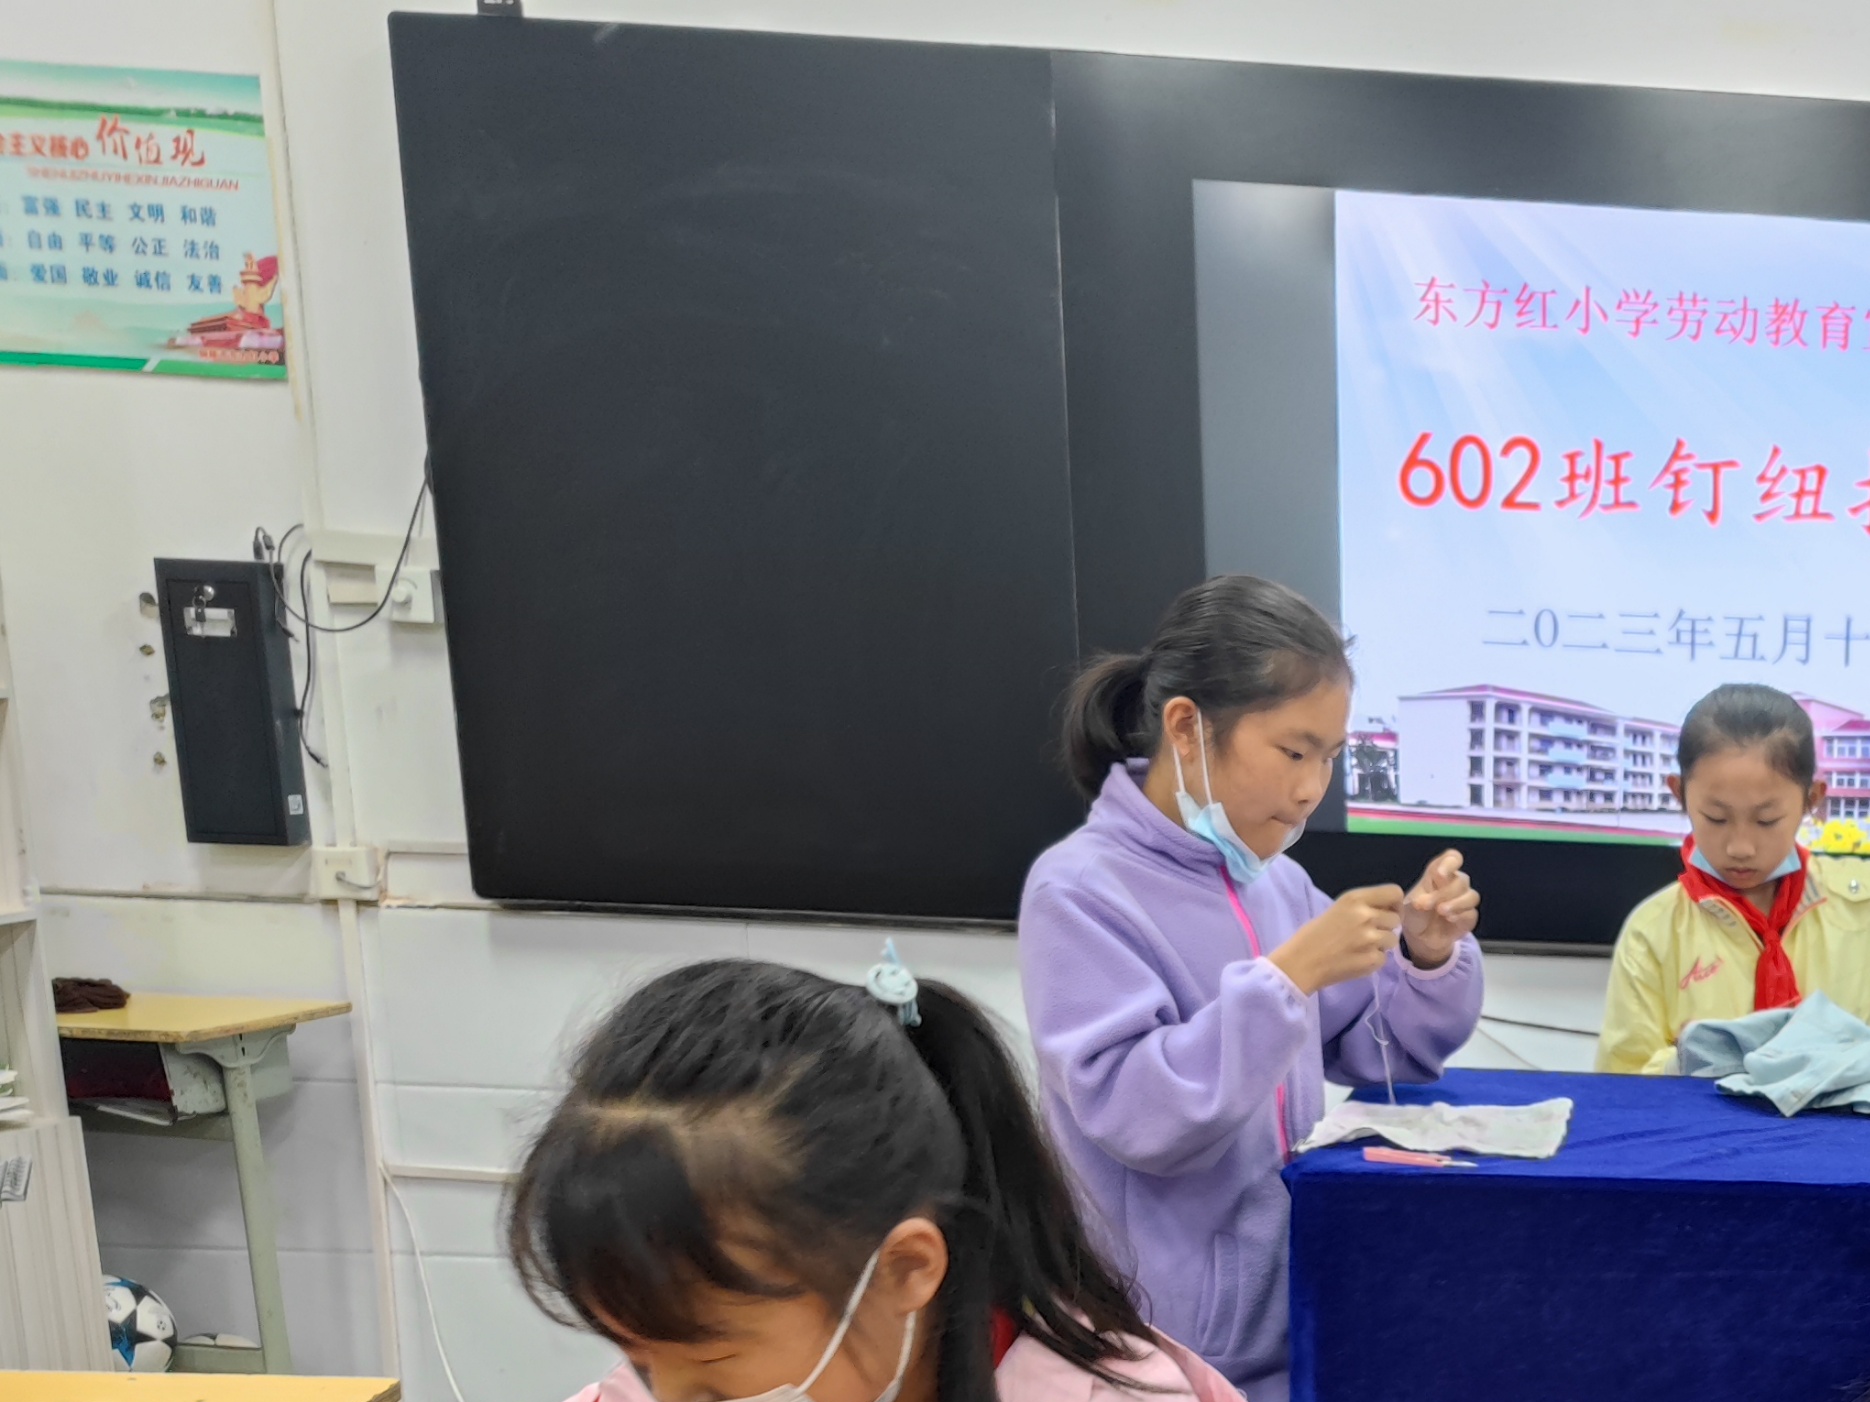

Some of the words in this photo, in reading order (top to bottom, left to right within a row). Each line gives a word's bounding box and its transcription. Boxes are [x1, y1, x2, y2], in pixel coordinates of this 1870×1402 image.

[75, 198, 113, 221] 民主
[128, 202, 165, 224] 文明
[181, 205, 217, 227] 和谐
[28, 230, 63, 251] 自由
[79, 232, 117, 254] 平等
[132, 236, 168, 256] 公正
[183, 238, 220, 260] 法治
[31, 263, 67, 285] 爱国
[83, 266, 119, 287] 敬业
[135, 269, 171, 291] 诚信
[187, 273, 222, 294] 友善
